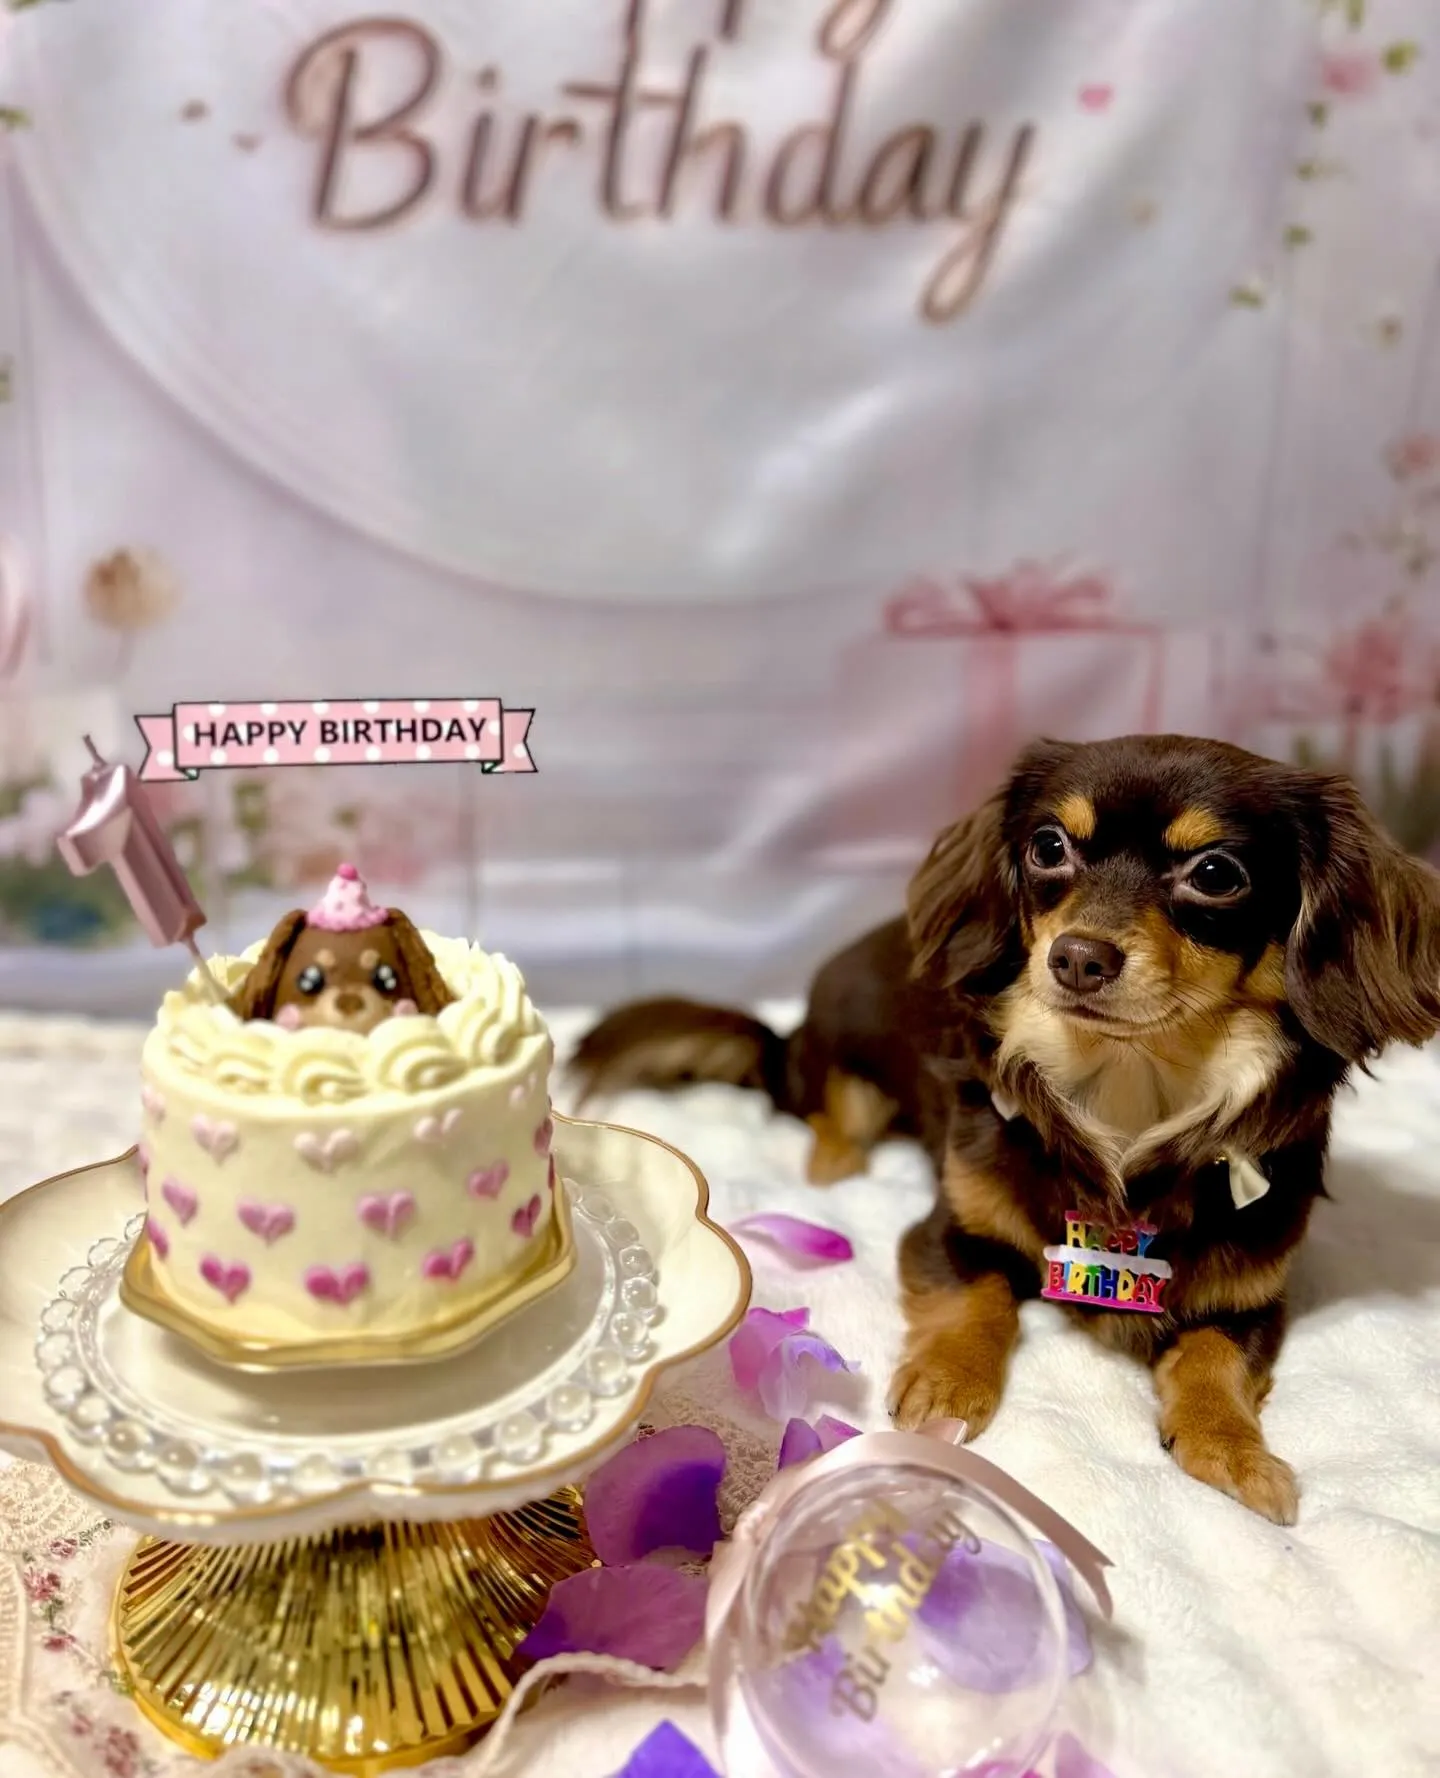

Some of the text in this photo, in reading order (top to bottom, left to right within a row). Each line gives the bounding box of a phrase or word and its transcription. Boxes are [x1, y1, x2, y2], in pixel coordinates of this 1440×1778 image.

[284, 16, 1035, 326] Birthday
[193, 717, 487, 748] HAPPY BIRTHDAY
[1066, 1220, 1155, 1258] HAPPY
[1049, 1260, 1167, 1305] BIRTHDAY
